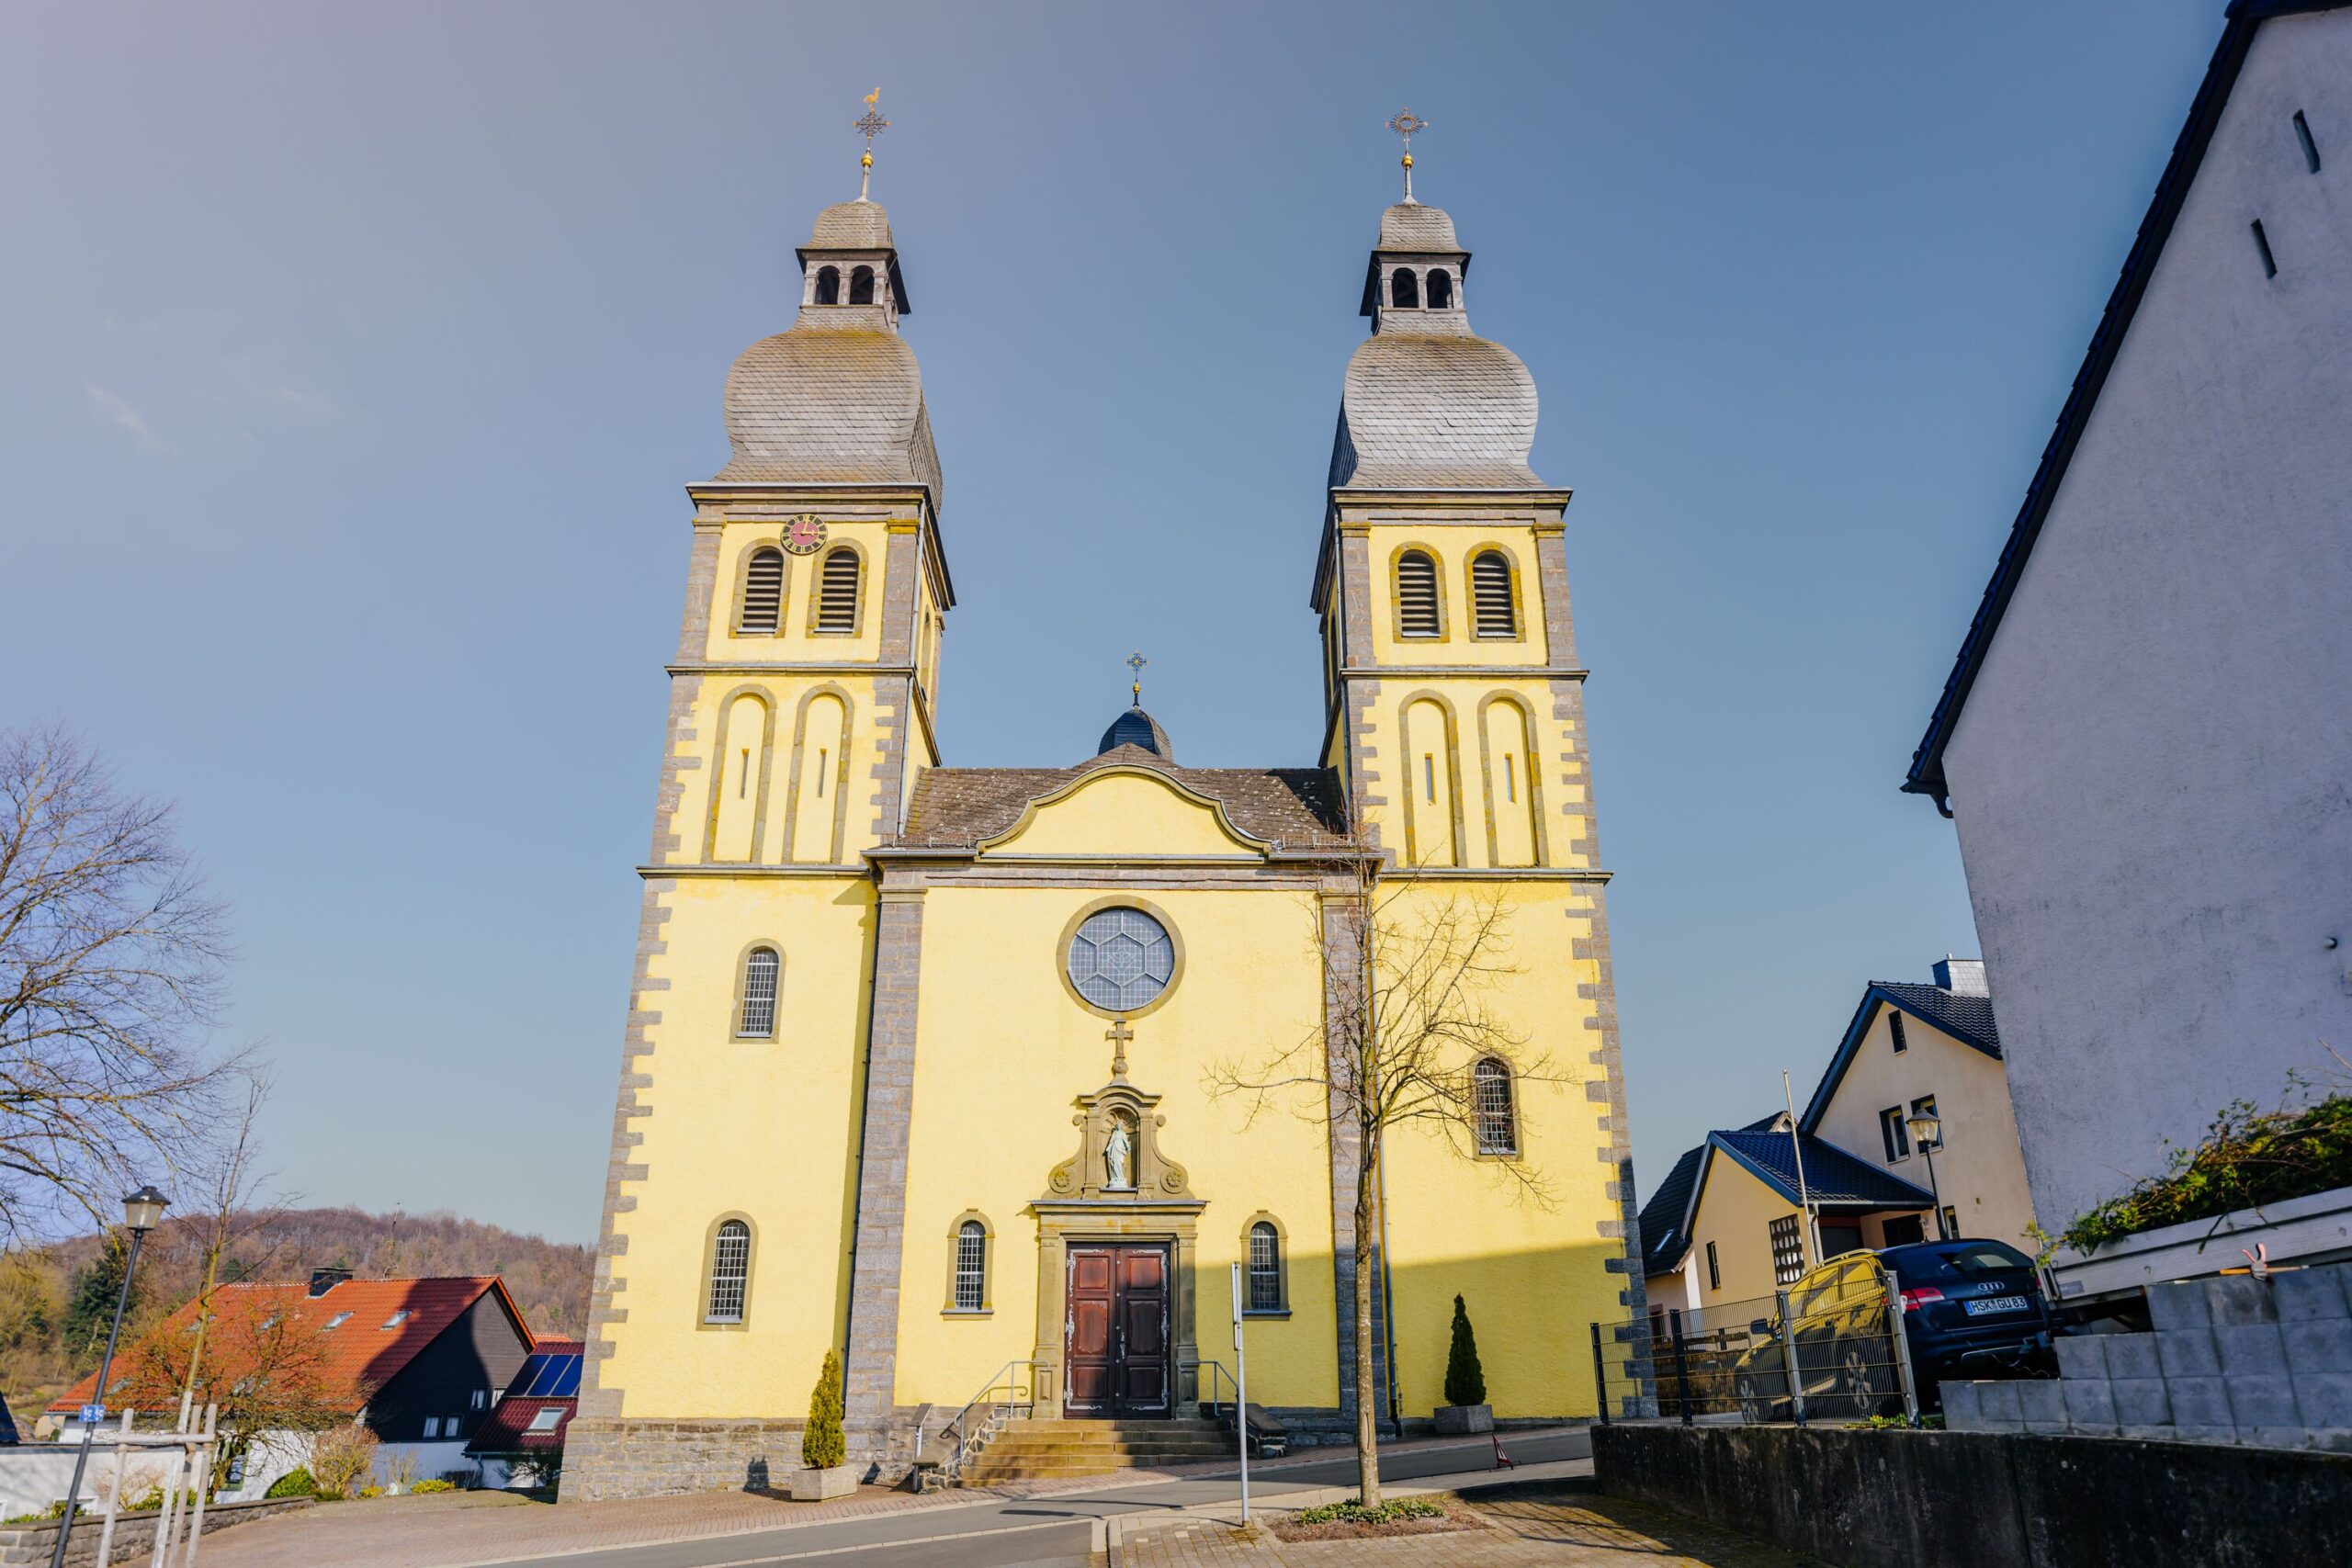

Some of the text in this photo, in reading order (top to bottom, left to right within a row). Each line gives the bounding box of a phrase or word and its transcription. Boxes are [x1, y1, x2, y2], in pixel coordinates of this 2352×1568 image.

[1971, 1297, 2026, 1312] HSK GU 83
